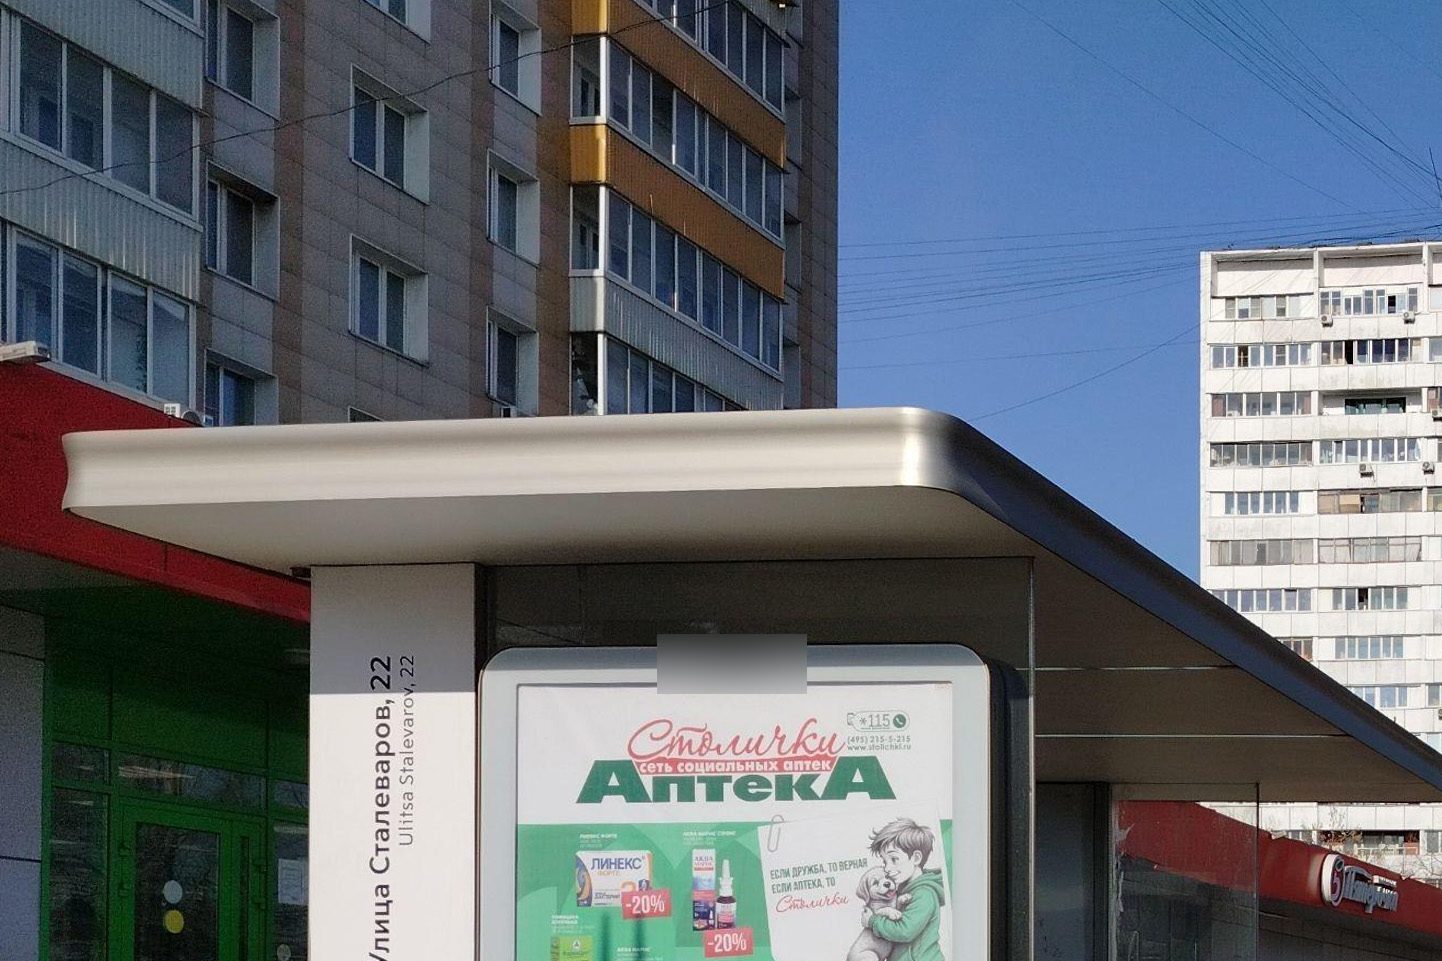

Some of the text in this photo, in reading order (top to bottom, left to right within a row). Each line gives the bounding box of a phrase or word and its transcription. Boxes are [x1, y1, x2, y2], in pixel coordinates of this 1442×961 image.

[370, 656, 391, 691] 22
[628, 718, 845, 760] Столички
[847, 734, 869, 744] (495)
[847, 743, 912, 752] www.stolichki.ru
[399, 655, 416, 846] Ulitsa Stalevarov, 22
[639, 760, 831, 774] сеть социальных аптек
[369, 699, 395, 875] Сталеваров,
[575, 758, 898, 804] АптекА
[591, 857, 643, 870] ЛИНЕКС
[770, 857, 868, 880] ЕСЛИ ДРУЖБА, ТО ВЕРНАЯ
[771, 876, 836, 894] ЕСЛИ АПТЕКА, ТО
[625, 894, 665, 914] -20%
[775, 892, 849, 913] Столички
[707, 932, 747, 953] -20%
